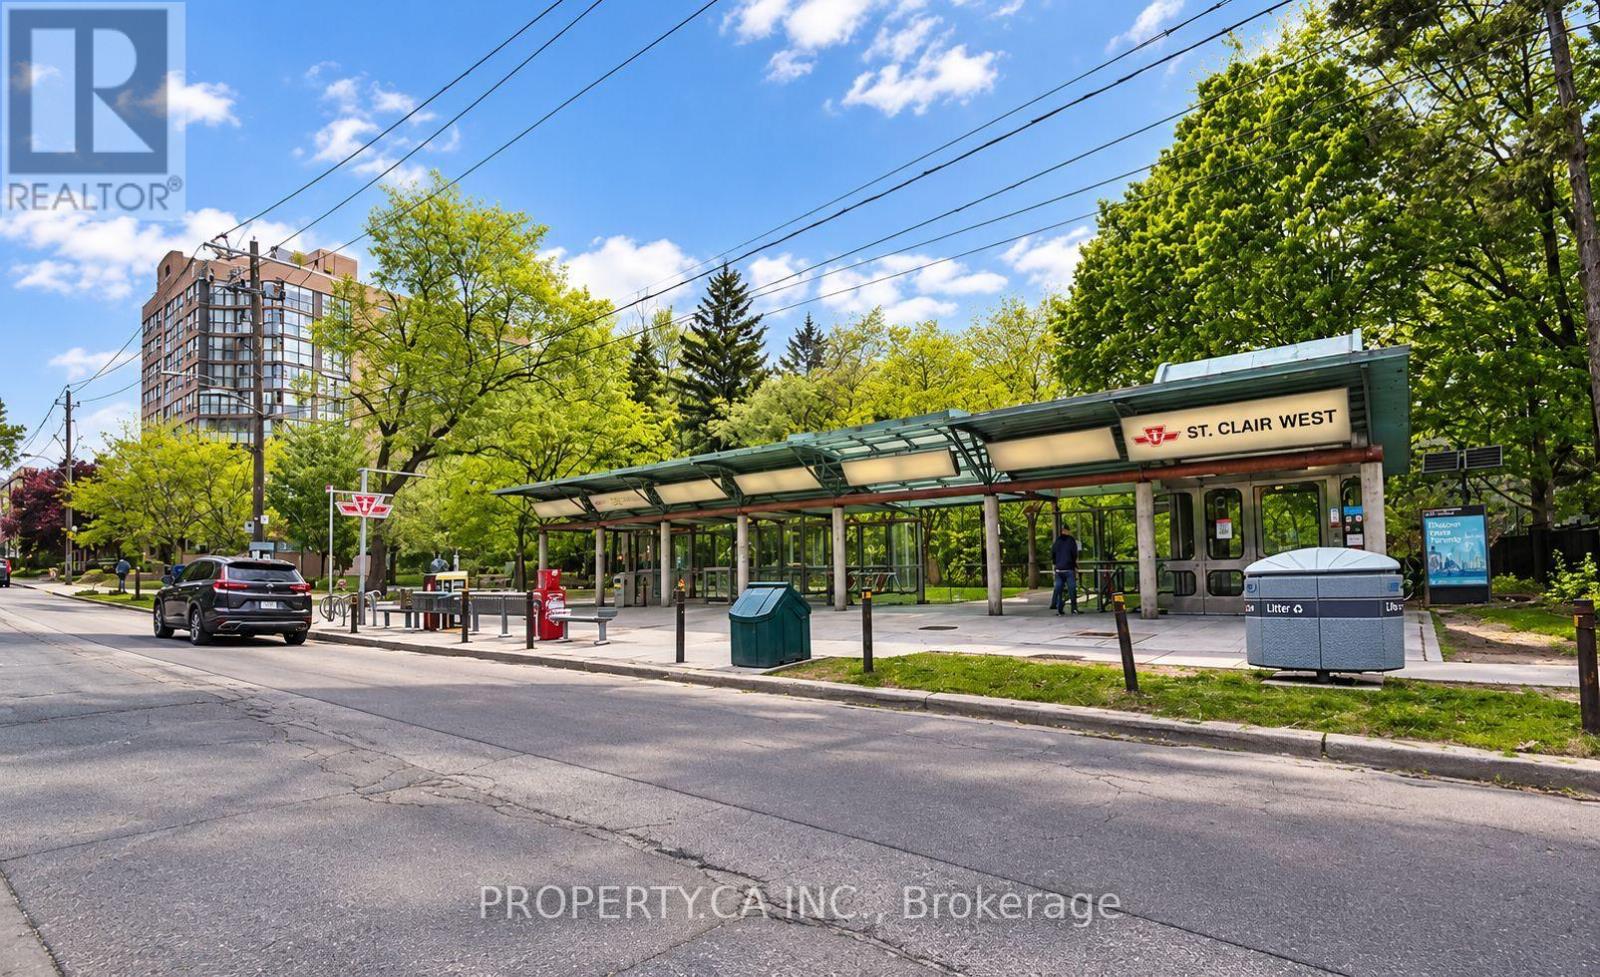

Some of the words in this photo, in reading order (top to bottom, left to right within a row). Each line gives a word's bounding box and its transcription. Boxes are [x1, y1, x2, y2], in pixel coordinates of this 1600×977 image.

[1187, 424, 1212, 439] ST.
[1218, 417, 1272, 435] CLAIR
[1279, 409, 1337, 429] WEST
[1267, 603, 1290, 613] Litter
